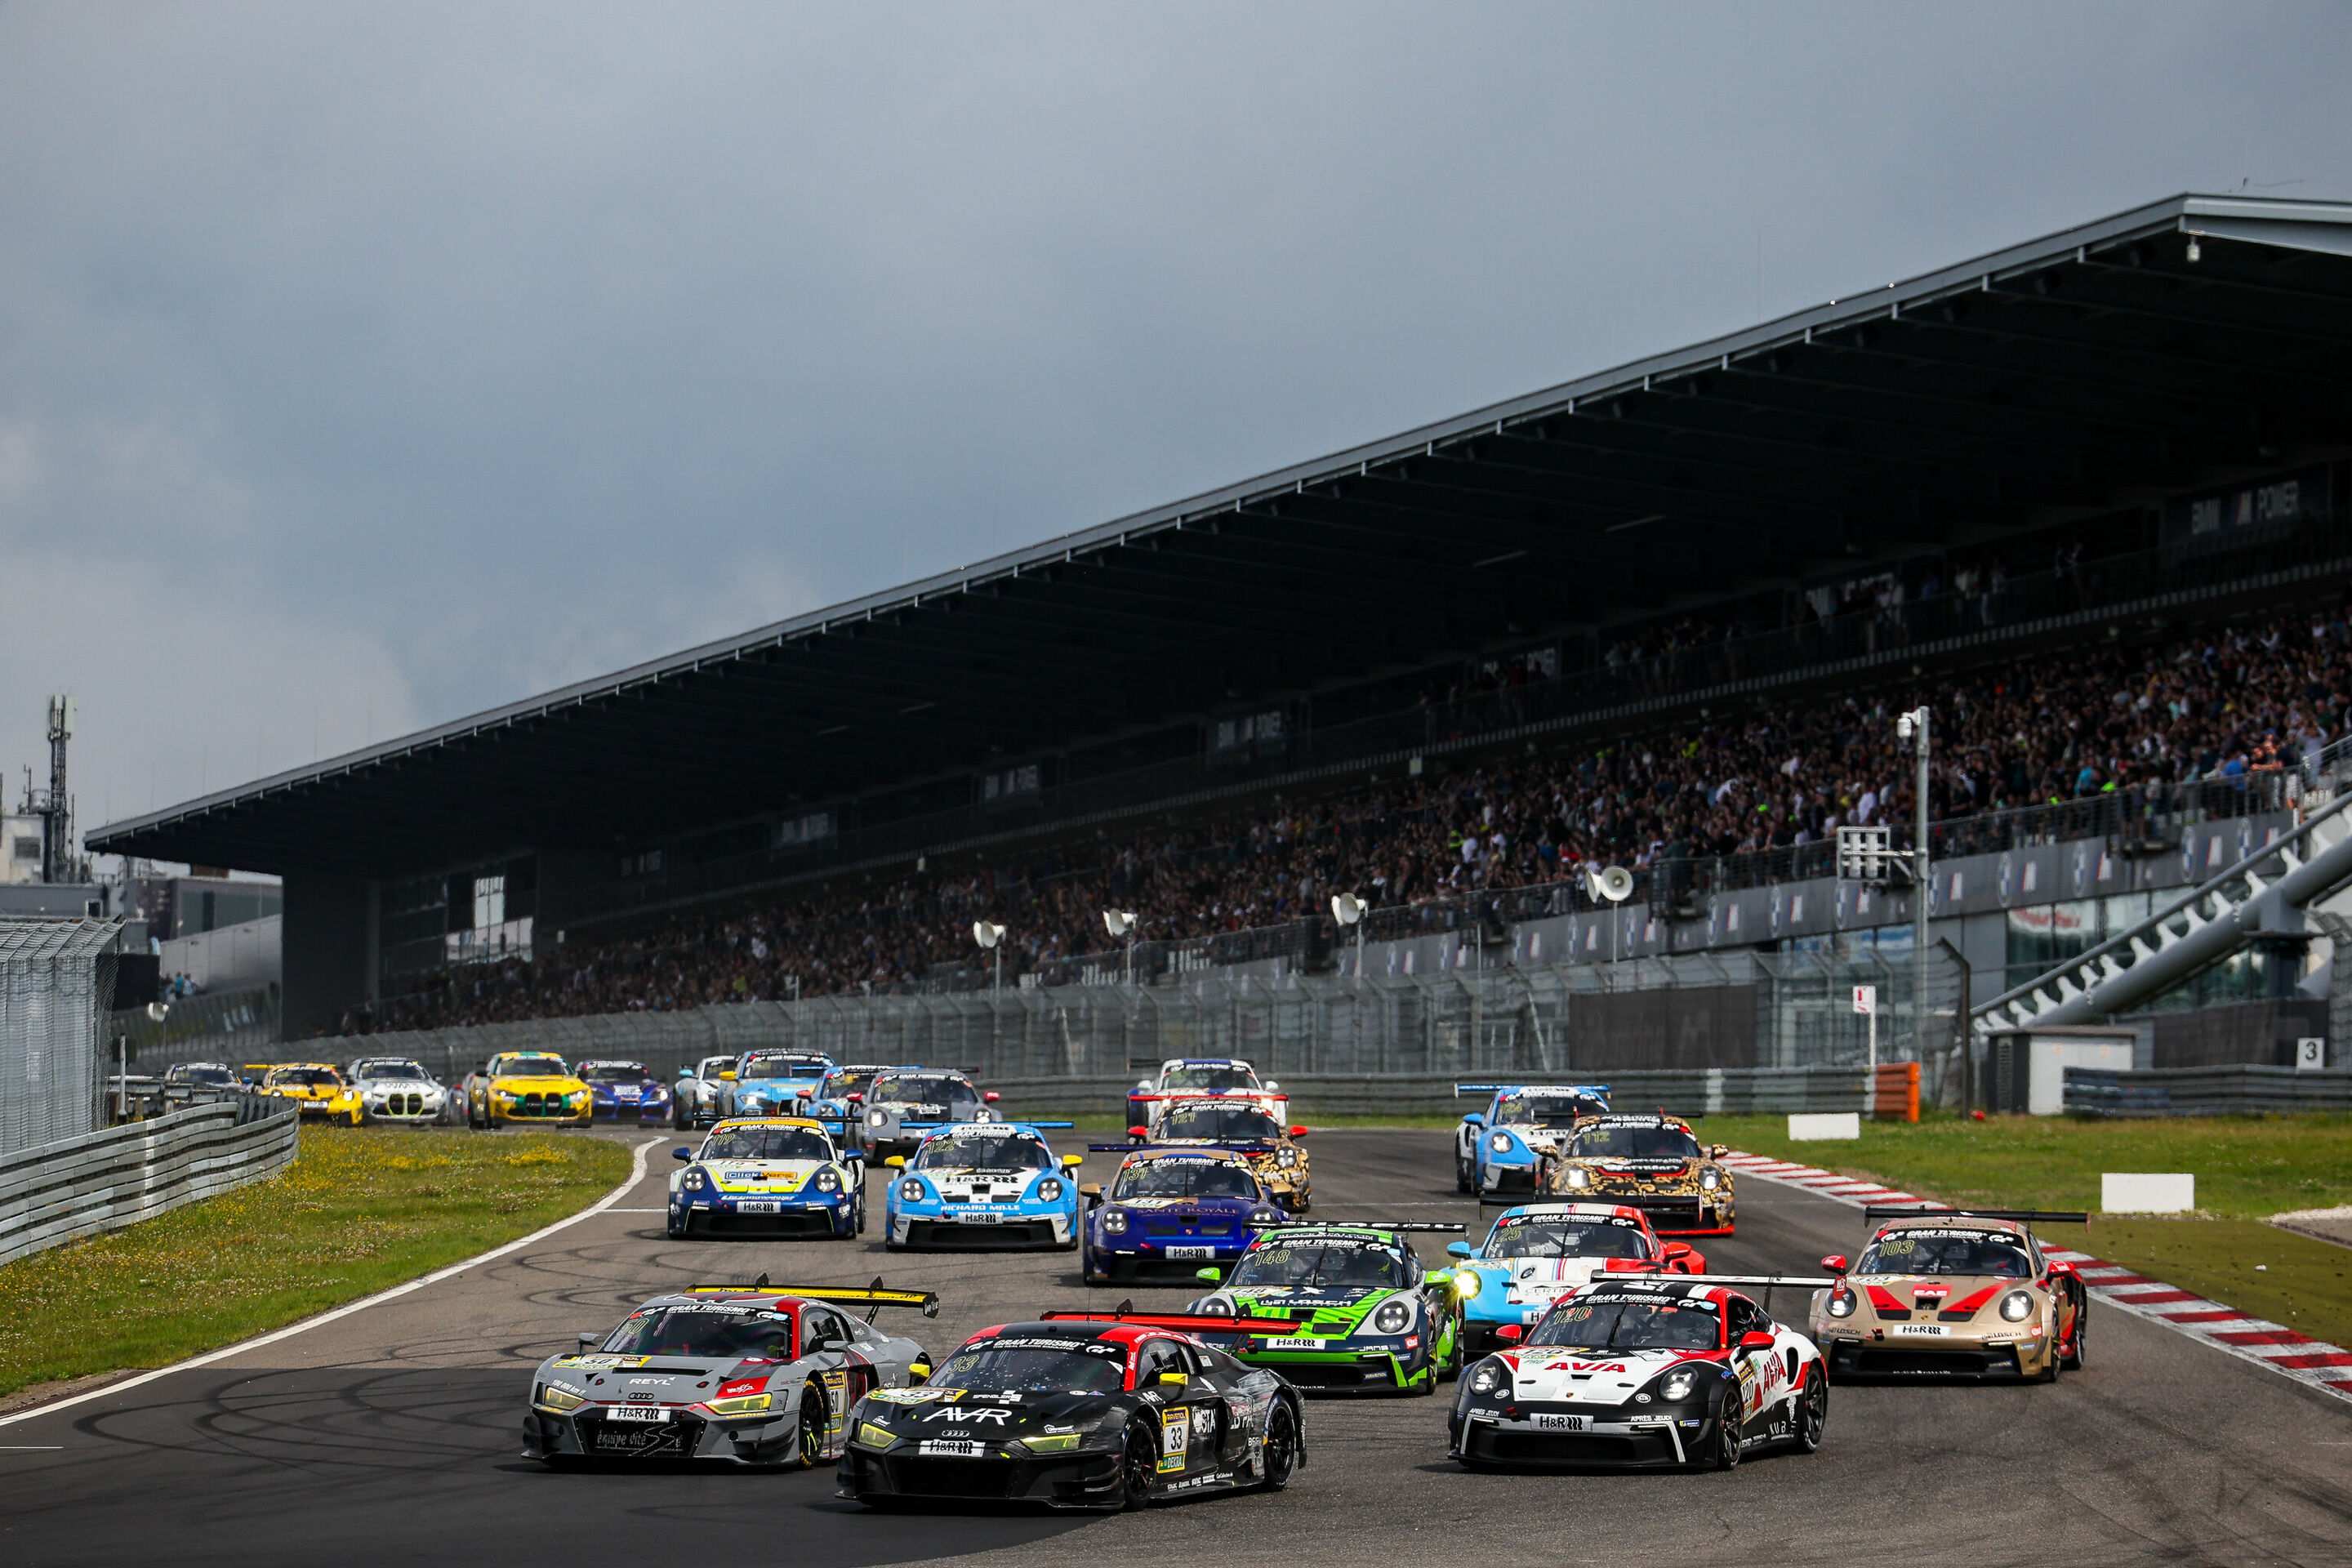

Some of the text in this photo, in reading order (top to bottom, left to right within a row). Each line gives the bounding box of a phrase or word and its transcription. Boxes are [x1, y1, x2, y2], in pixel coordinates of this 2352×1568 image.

[2305, 1041, 2318, 1062] 3
[1879, 1240, 1915, 1257] 103
[1255, 1250, 1290, 1266] 148
[1619, 1294, 1671, 1303] TURISMO
[666, 1304, 699, 1312] GRAN
[701, 1305, 753, 1314] TURISMO
[1553, 1305, 1592, 1325] 120
[617, 1317, 650, 1334] 50
[995, 1338, 1028, 1347] GRAN
[1029, 1339, 1080, 1348] TURISMO
[947, 1355, 979, 1374] 33
[922, 1407, 1013, 1426] AVR
[1166, 1410, 1187, 1421] RAVENOL
[1540, 1415, 1566, 1428] H&R
[1170, 1427, 1183, 1450] 33
